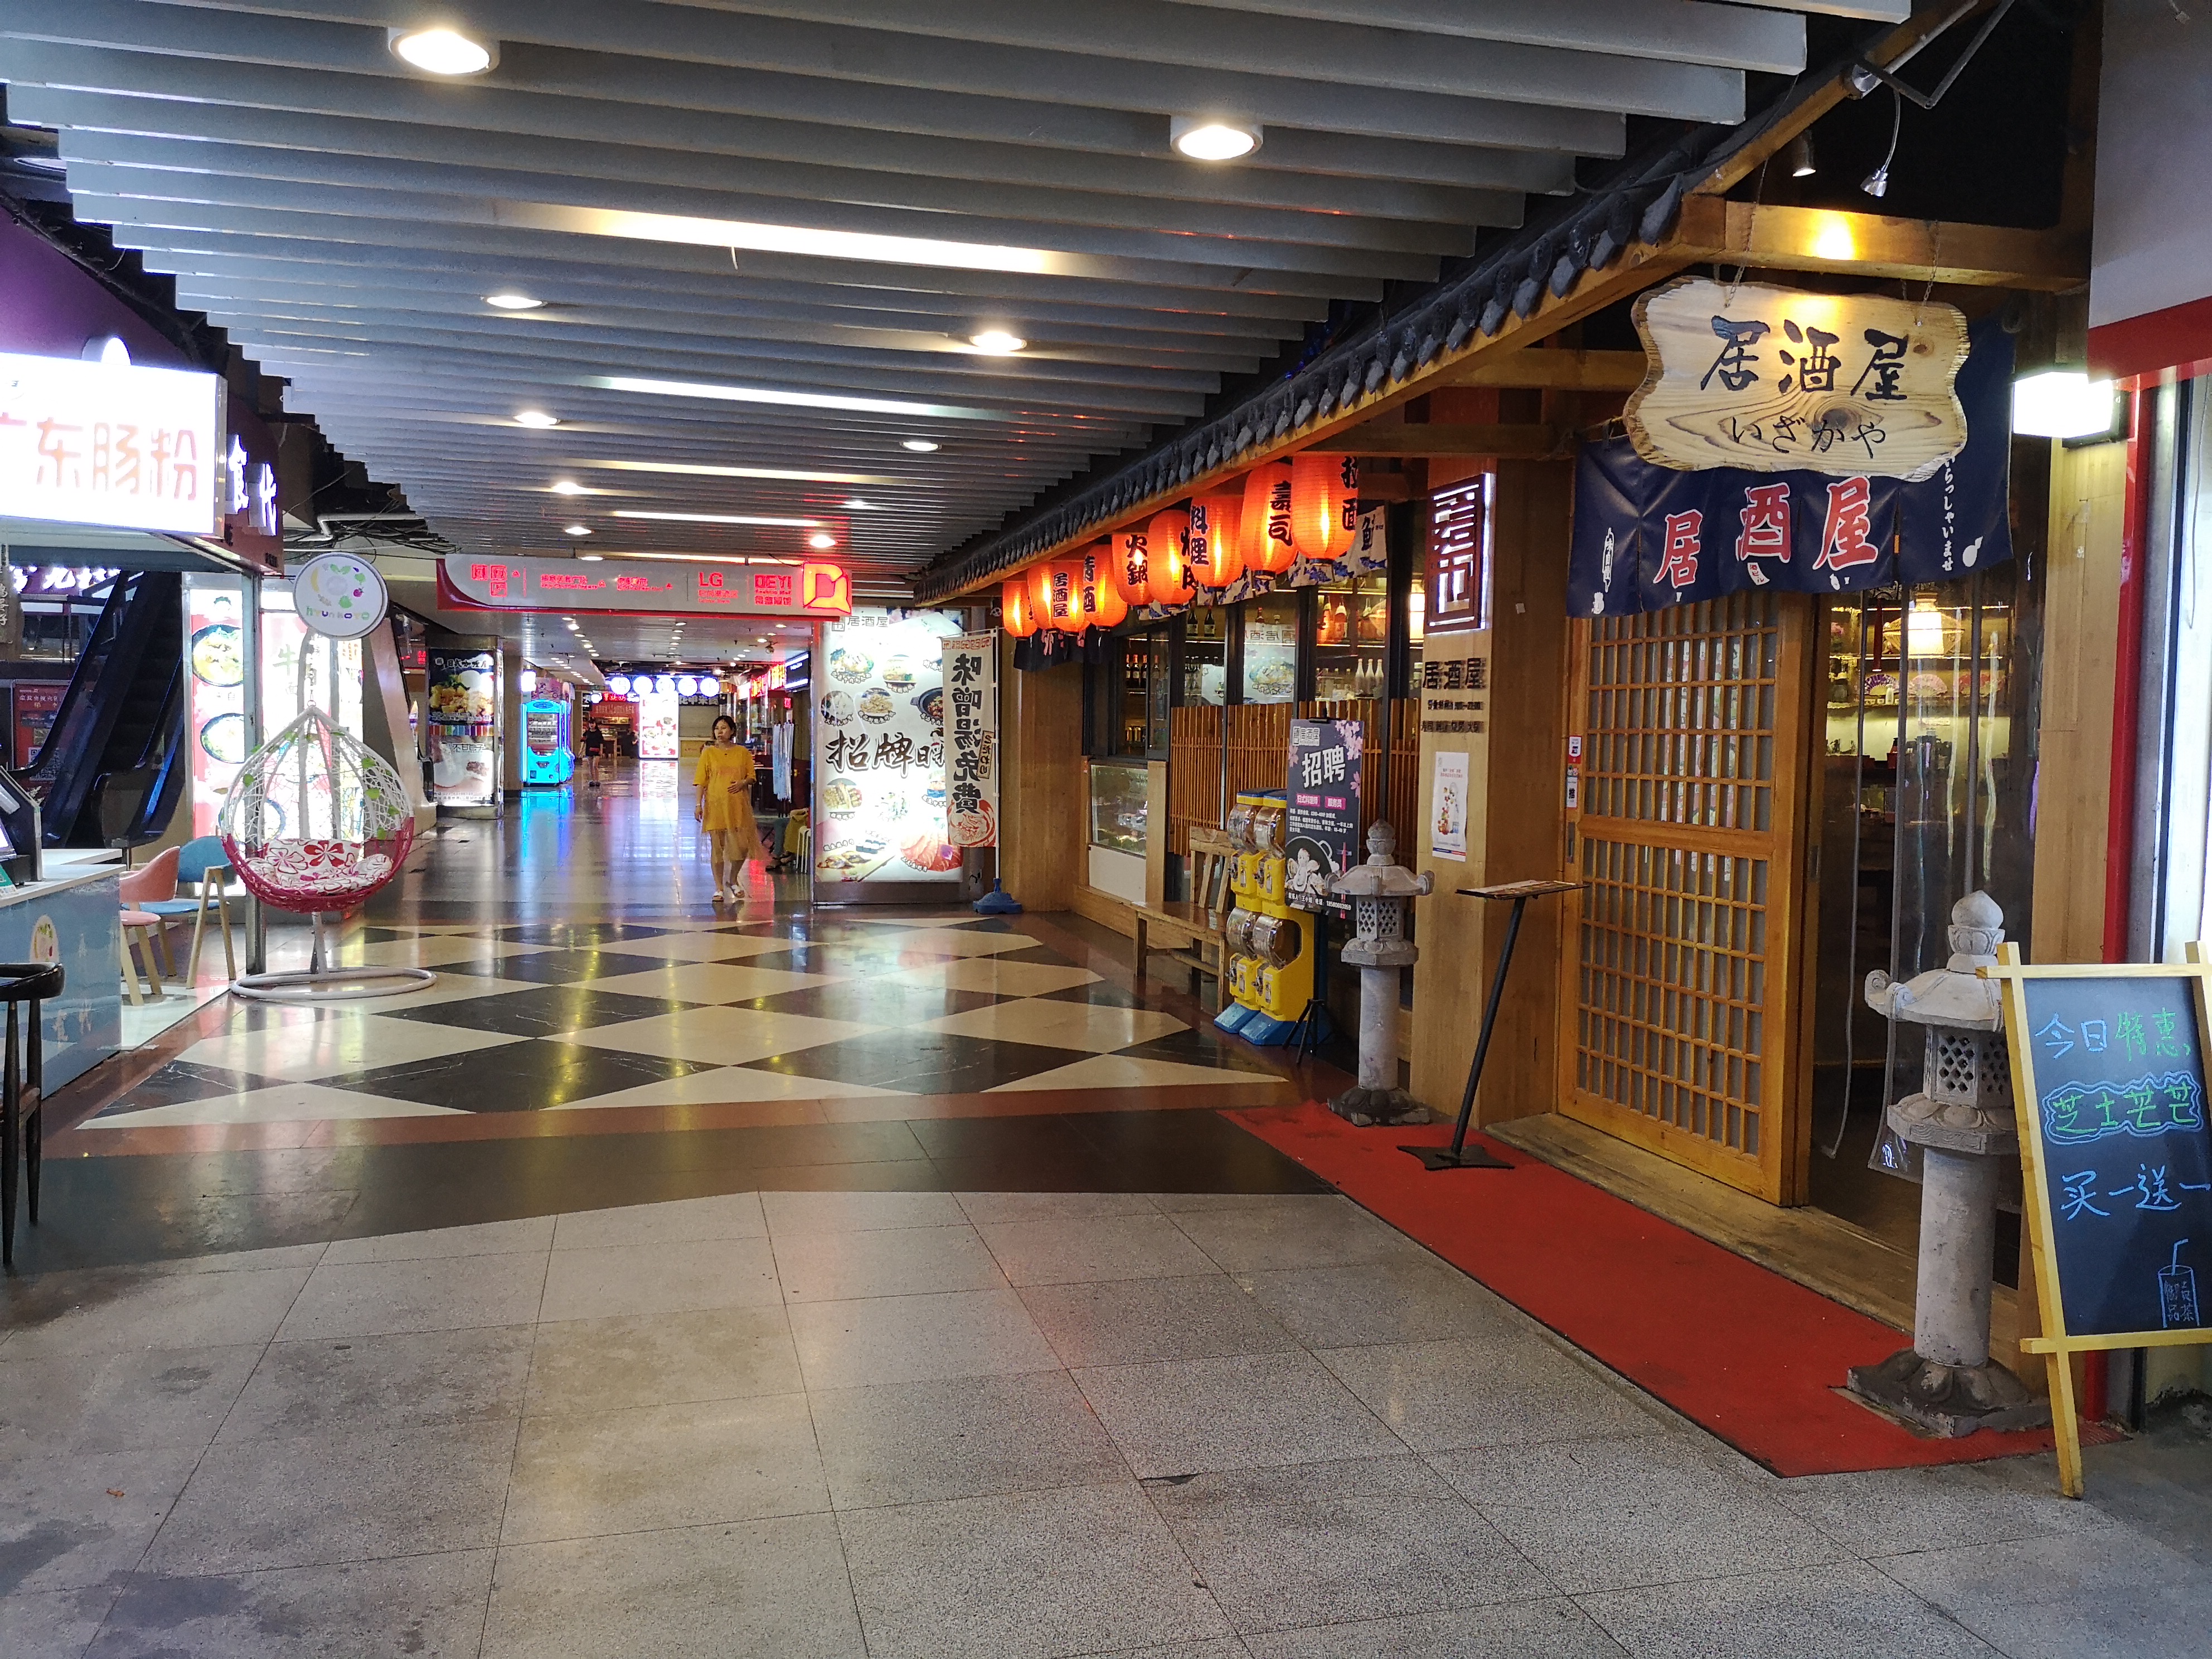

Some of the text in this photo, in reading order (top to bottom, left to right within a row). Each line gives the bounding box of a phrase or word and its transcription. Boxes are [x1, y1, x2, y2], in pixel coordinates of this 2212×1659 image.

[1700, 315, 1909, 400] 居酒屋
[1732, 415, 1886, 459] いざかや
[1653, 476, 1879, 589] 居酒屋
[699, 572, 723, 587] LG
[755, 575, 792, 590] DEYI
[1054, 573, 1069, 617] 居酒屋
[847, 616, 889, 628] 居酒屋
[1423, 658, 1483, 690] 居酒屋
[1302, 745, 1346, 788] 招聘
[2035, 1007, 2191, 1061] 今日特惠
[2053, 1081, 2197, 1133] 芝士芒芒
[2061, 1163, 2211, 1221] 买一送一
